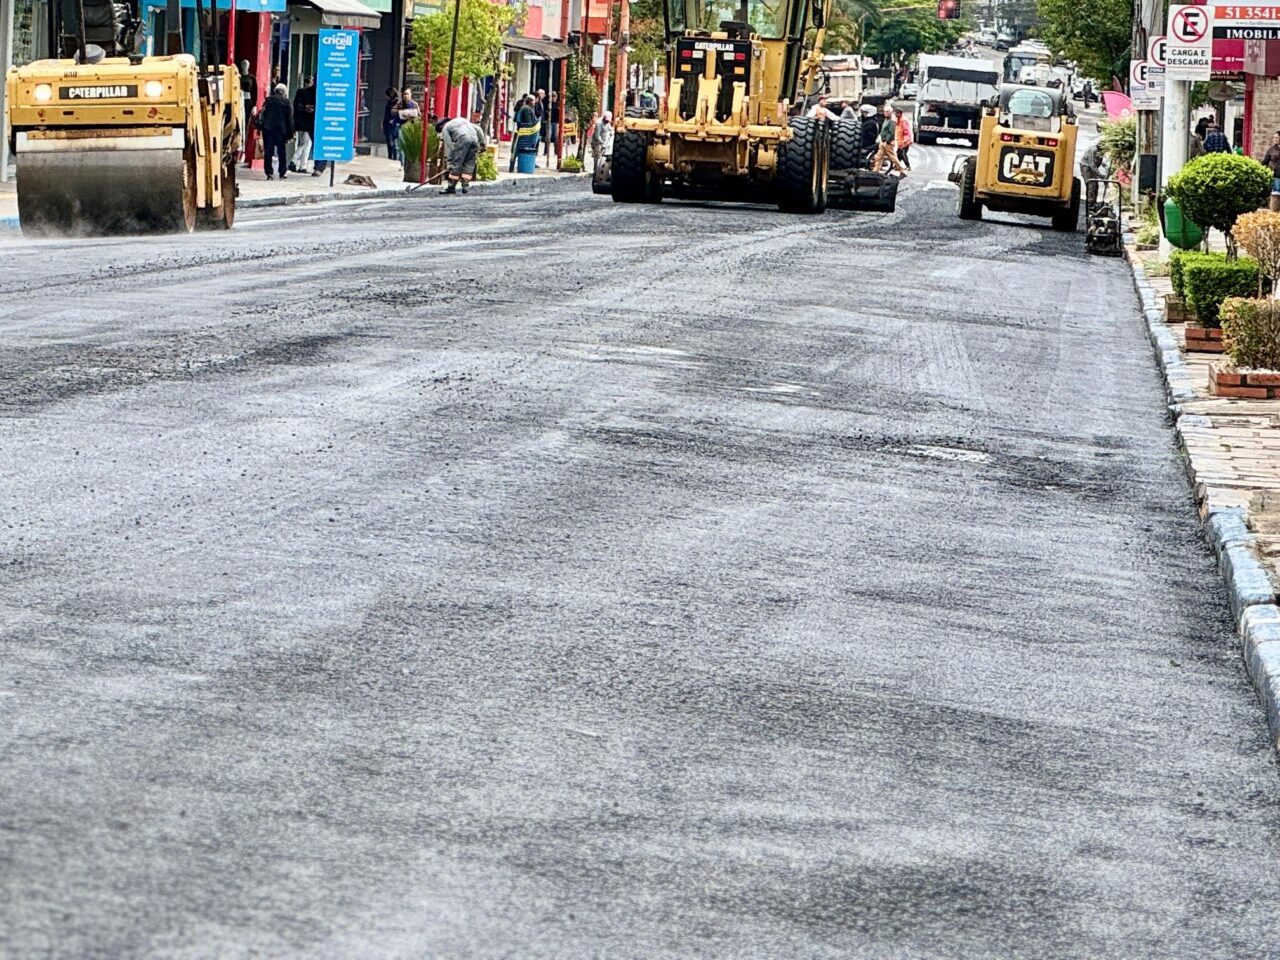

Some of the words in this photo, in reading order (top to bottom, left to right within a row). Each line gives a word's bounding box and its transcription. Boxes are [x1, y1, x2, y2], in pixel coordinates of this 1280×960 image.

[1225, 7, 1241, 18] 51
[322, 34, 352, 48] cricell
[694, 42, 735, 51] CATERPILLAR
[1171, 49, 1199, 57] CARGA
[68, 86, 128, 98] CATERPILLAR
[1003, 152, 1051, 184] CAT
